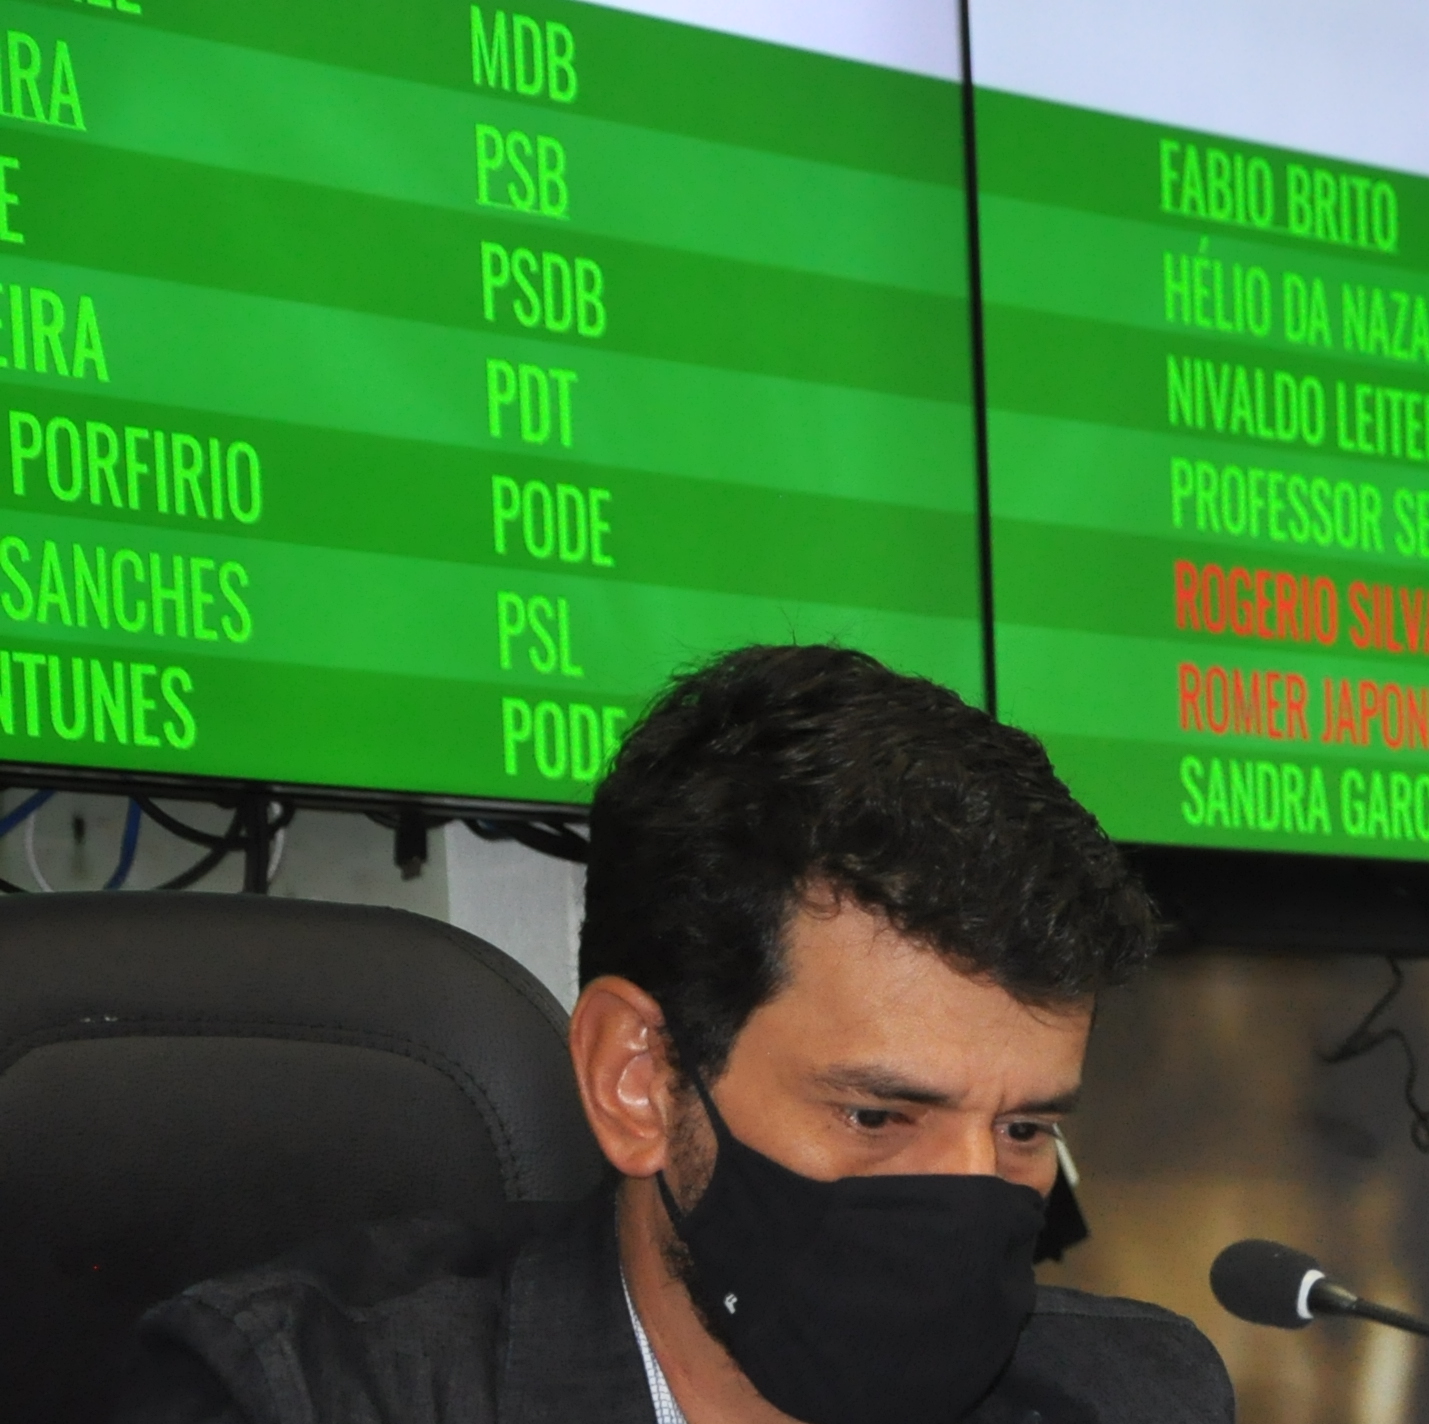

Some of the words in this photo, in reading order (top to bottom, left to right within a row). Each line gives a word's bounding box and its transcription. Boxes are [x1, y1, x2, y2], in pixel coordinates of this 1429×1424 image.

[0, 29, 87, 131] RA
[470, 5, 578, 102] MDB
[475, 123, 569, 218] PSB
[1159, 138, 1275, 229] FABIO
[1286, 163, 1397, 252] BRITO
[481, 240, 607, 338] PSDB
[1163, 237, 1271, 338] HÉLIO
[1283, 272, 1332, 350] DA
[487, 358, 578, 447] PDT
[1166, 354, 1325, 448] NIVALDO
[7, 409, 264, 525] PORFIRIO
[1169, 456, 1385, 554] PROFESSOR
[491, 474, 615, 568] PODE
[0, 535, 253, 643] SANCHES
[498, 590, 584, 678] PSL
[1173, 559, 1339, 645] ROGERIO
[1178, 662, 1308, 741] ROMER
[1180, 755, 1331, 834] SANDRA
